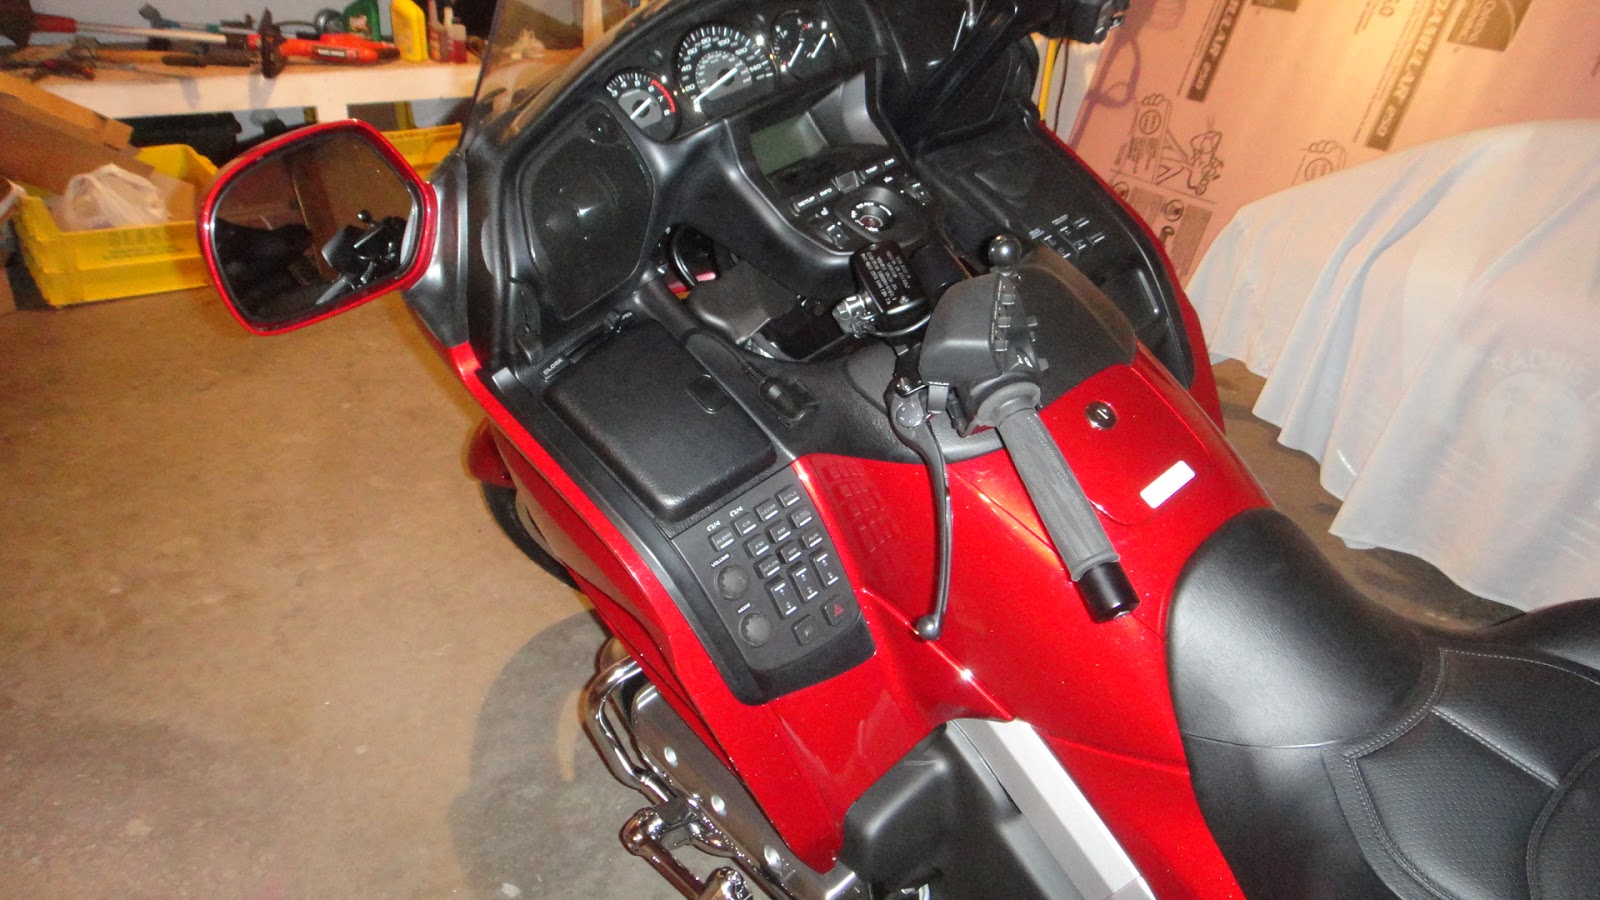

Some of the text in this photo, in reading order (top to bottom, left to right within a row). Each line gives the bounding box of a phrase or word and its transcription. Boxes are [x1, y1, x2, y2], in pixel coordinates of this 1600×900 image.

[681, 64, 692, 72] 40
[749, 63, 762, 72] 140
[685, 83, 696, 92] 20
[797, 196, 815, 207] SETUP
[543, 357, 563, 375] CLOSE
[716, 532, 732, 544] AUDIO
[710, 553, 730, 568] VOLUME
